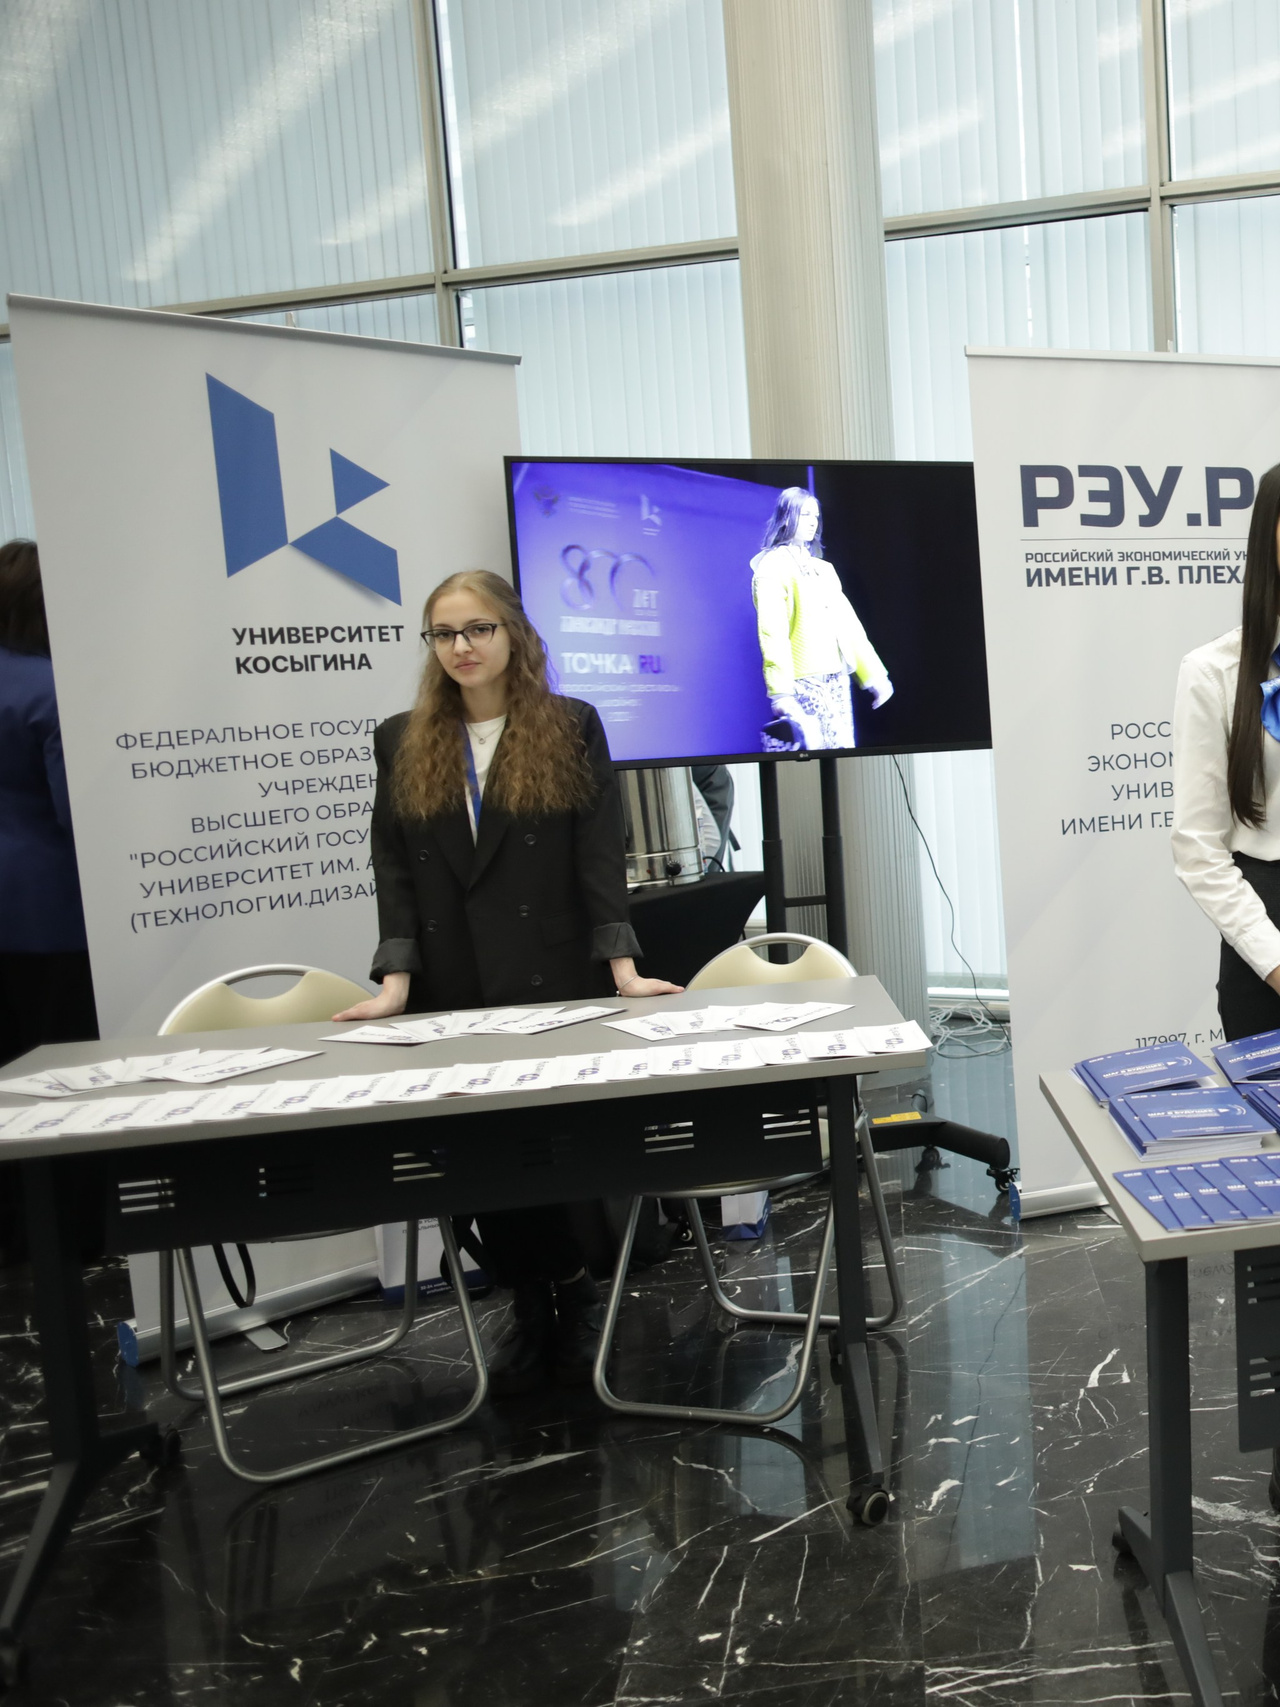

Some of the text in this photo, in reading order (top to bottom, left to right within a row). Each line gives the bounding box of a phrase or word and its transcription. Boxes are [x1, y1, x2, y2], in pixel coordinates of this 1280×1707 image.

[1020, 464, 1255, 528] РЭУ.Р
[1025, 548, 1248, 563] РОССИЙСКИЙ ЭКОНОМИЧЕСКИЙ УН
[1026, 565, 1245, 587] ИМЕНИ Г.В. ПЛЕХ
[232, 625, 404, 646] УНИВЕРСИТЕТ
[235, 653, 372, 674] КОСЫГИНА
[560, 652, 633, 674] ТОЧКА
[115, 718, 377, 751] ФЕДЕРАЛЬНОЕ ГОСУД
[1111, 721, 1171, 740] РОСС
[131, 746, 372, 779] БЮДЖЕТНОЕ ОБРАЗ
[1088, 751, 1173, 772] ЭКОНО
[258, 773, 377, 798] УЧРЕЖДЕН
[1111, 781, 1174, 801] УНИВ
[191, 801, 374, 834] ВЫСШЕГО ОБРА
[1061, 811, 1174, 835] ИМЕНИ Г.В
[130, 828, 369, 869] "РОССИЙСКИЙ ГОСУ
[139, 862, 313, 899] УНИВЕРСИТЕТ
[321, 857, 360, 875] ИМ.
[130, 878, 377, 934] (ТЕХНОЛОГИИ.ДИЗАЙ
[1195, 1033, 1205, 1043] г.
[1210, 1028, 1223, 1041] М
